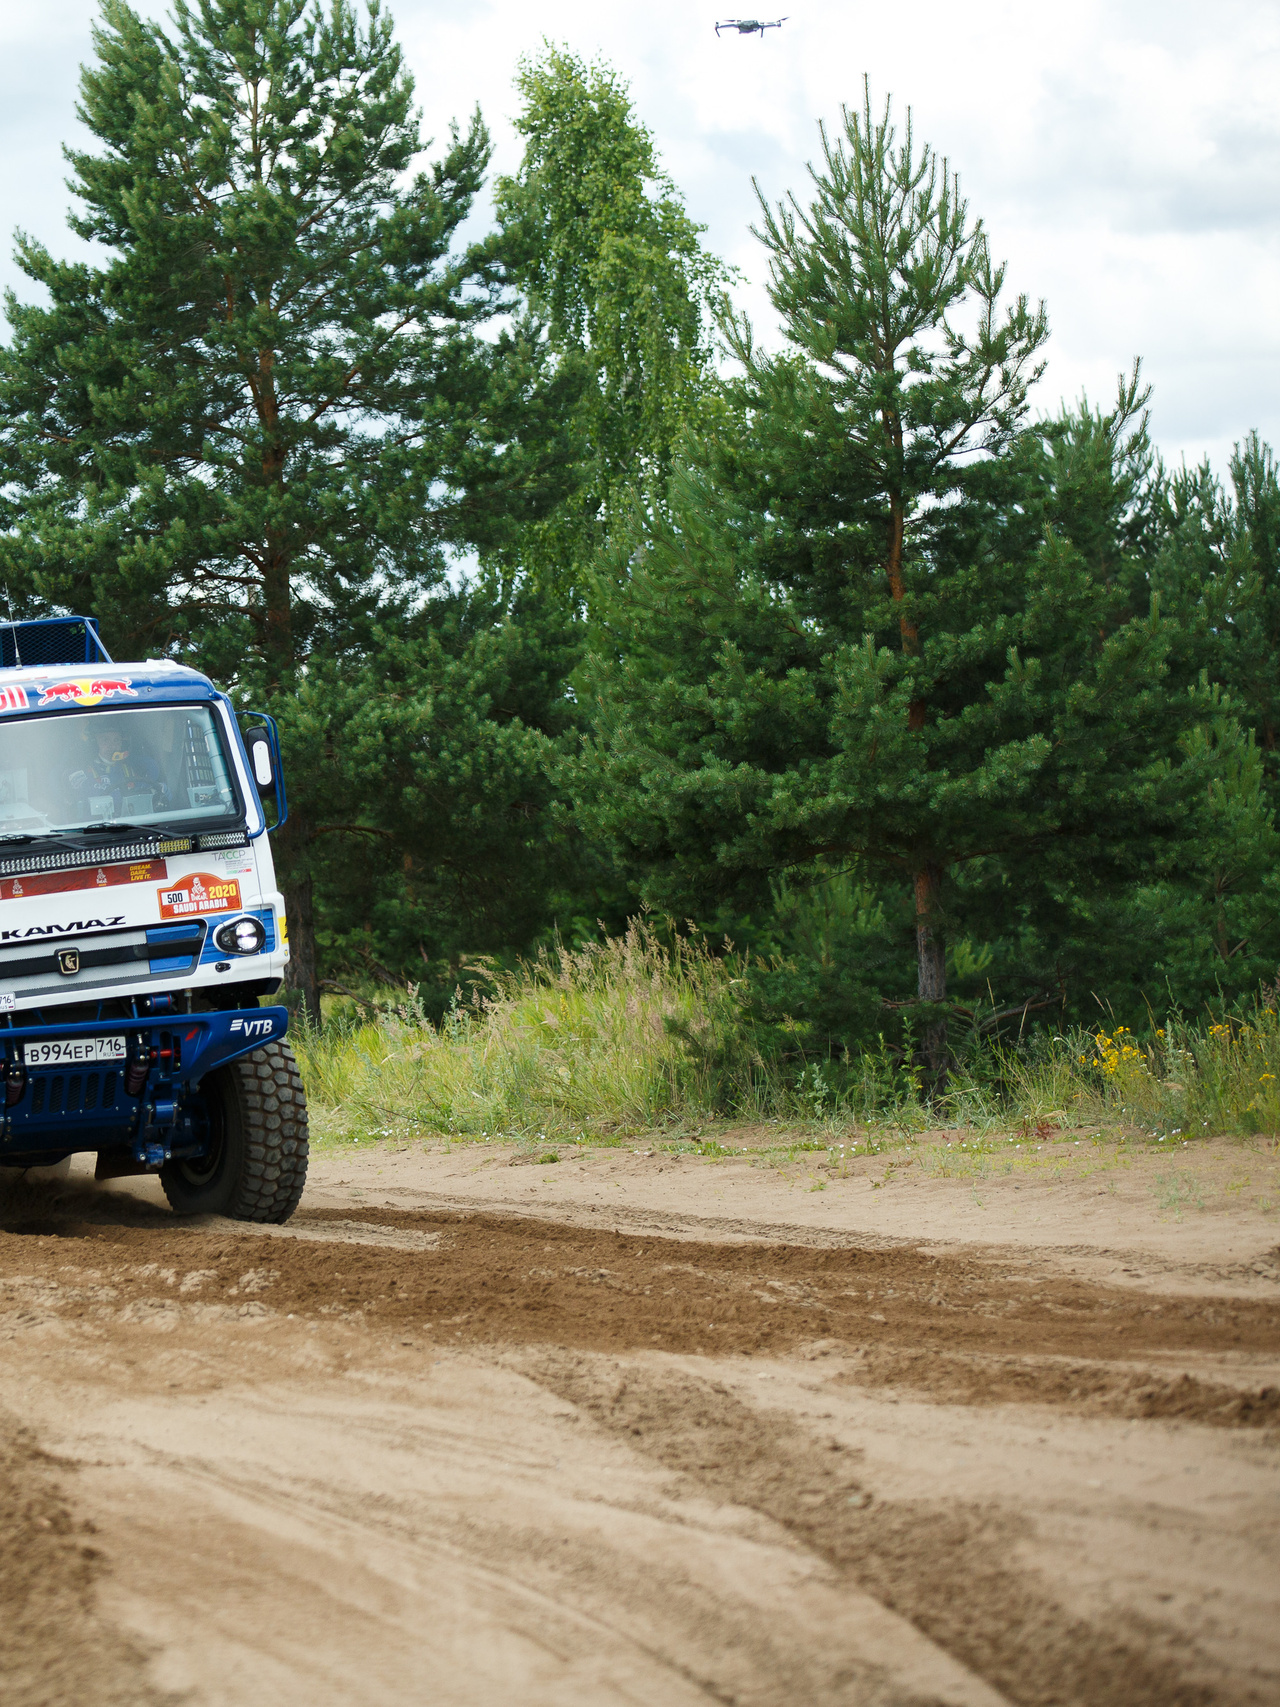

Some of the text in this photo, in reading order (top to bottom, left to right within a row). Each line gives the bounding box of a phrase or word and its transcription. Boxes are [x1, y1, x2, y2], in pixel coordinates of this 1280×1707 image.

[167, 892, 183, 904] 500
[208, 884, 237, 899] 2020
[173, 898, 228, 914] SAUDI ARABIA
[1, 915, 126, 940] KAMAZ
[243, 1019, 273, 1037] VTB
[97, 1039, 121, 1053] 716
